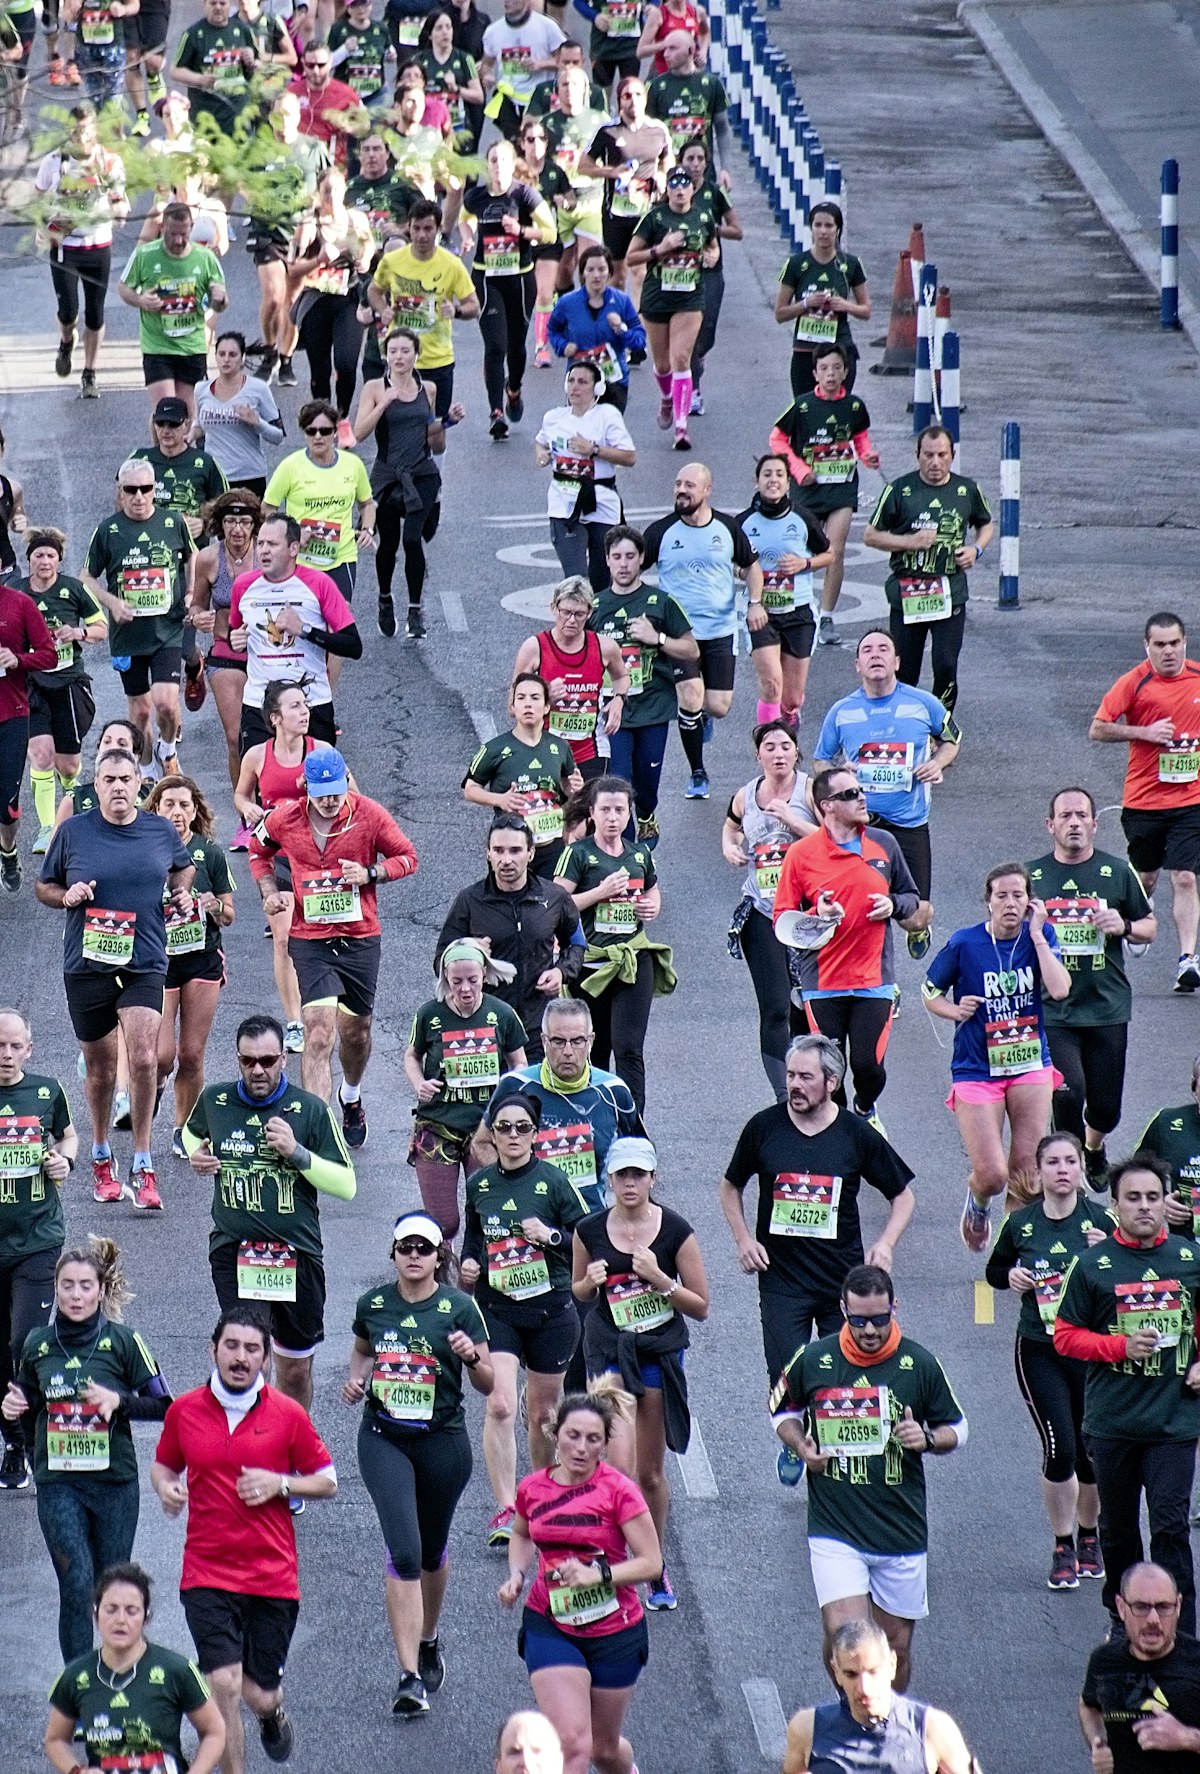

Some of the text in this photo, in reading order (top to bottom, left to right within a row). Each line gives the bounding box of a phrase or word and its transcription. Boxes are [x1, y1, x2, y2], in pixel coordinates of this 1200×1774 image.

[155, 492, 172, 500] ADRID
[122, 556, 149, 566] MADRID
[137, 595, 159, 606] 40802
[598, 632, 624, 641] ADRID
[564, 682, 599, 694] NMARK
[557, 718, 587, 731] F40529
[872, 770, 896, 782] 26301
[320, 899, 345, 912] 43163
[170, 930, 194, 944] 40901
[1063, 930, 1090, 943] 42954
[97, 940, 123, 954] 42936
[986, 994, 1034, 1011] FOR THE
[465, 1030, 476, 1039] edp
[999, 1045, 1032, 1063] F41624
[455, 1061, 489, 1077] F40676
[7, 1118, 18, 1128] edp
[232, 1130, 246, 1141] edp
[220, 1142, 256, 1154] MADRID
[2, 1151, 31, 1166] 41756
[557, 1156, 585, 1175] 2571
[799, 1176, 811, 1185] edp
[488, 1215, 501, 1226] edp
[790, 1209, 820, 1225] 42572
[1035, 1260, 1048, 1270] edp
[256, 1275, 284, 1289] 41644
[501, 1269, 539, 1290] F40694
[624, 1296, 662, 1324] F40897
[384, 1330, 398, 1342] edp
[375, 1343, 408, 1355] MADRID
[400, 1355, 413, 1364] edp
[383, 1388, 423, 1405] F40834
[842, 1390, 854, 1399] edp
[837, 1425, 870, 1442] 42659
[59, 1438, 97, 1457] F41987
[564, 1592, 604, 1614] F40951
